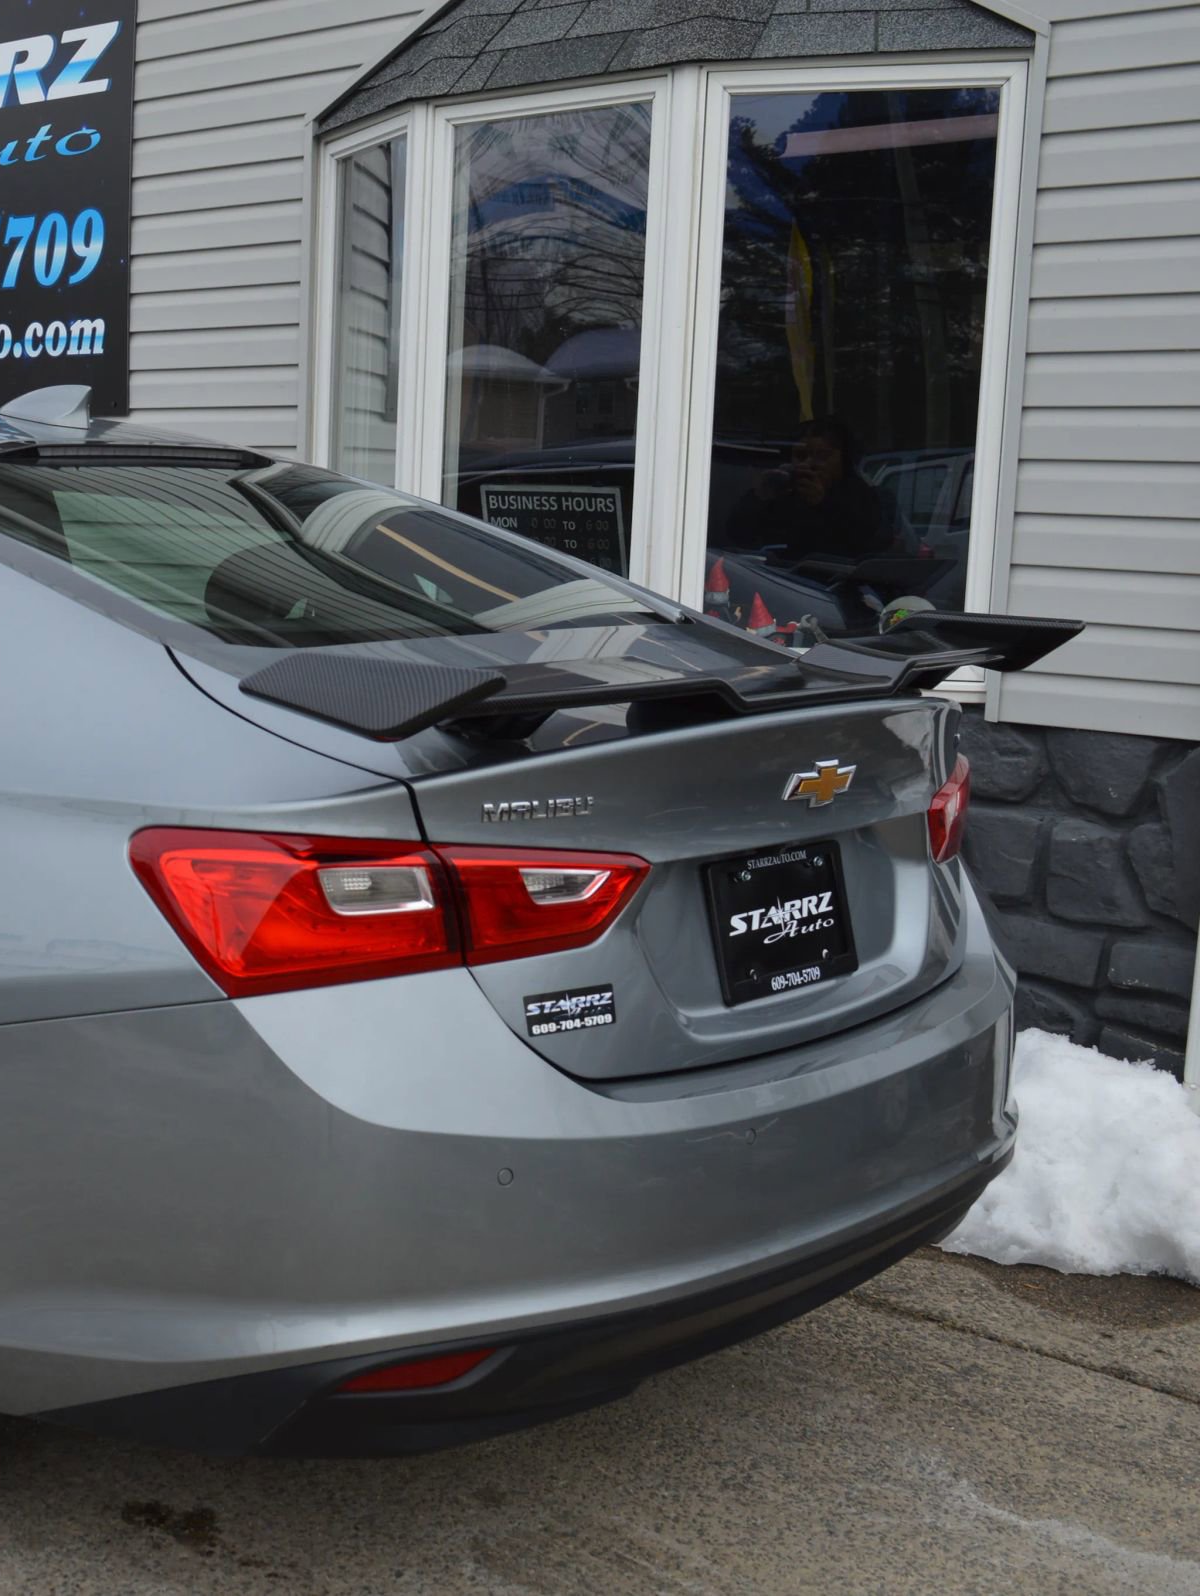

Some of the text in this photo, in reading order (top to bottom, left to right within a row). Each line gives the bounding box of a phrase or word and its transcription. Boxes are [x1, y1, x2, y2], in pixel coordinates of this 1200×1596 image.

[488, 495, 616, 513] BUSINESS HOURS
[489, 516, 518, 529] MON
[562, 520, 576, 531] TO
[564, 538, 578, 549] TO
[482, 796, 594, 822] MALIBU
[747, 849, 808, 870] STARRZAUTO.COM
[729, 891, 834, 937] STARRZ
[763, 918, 835, 944] Auto
[771, 966, 821, 991] 609-704-5709
[525, 991, 613, 1016] STARRZ
[531, 1013, 613, 1035] 609-704-5709
